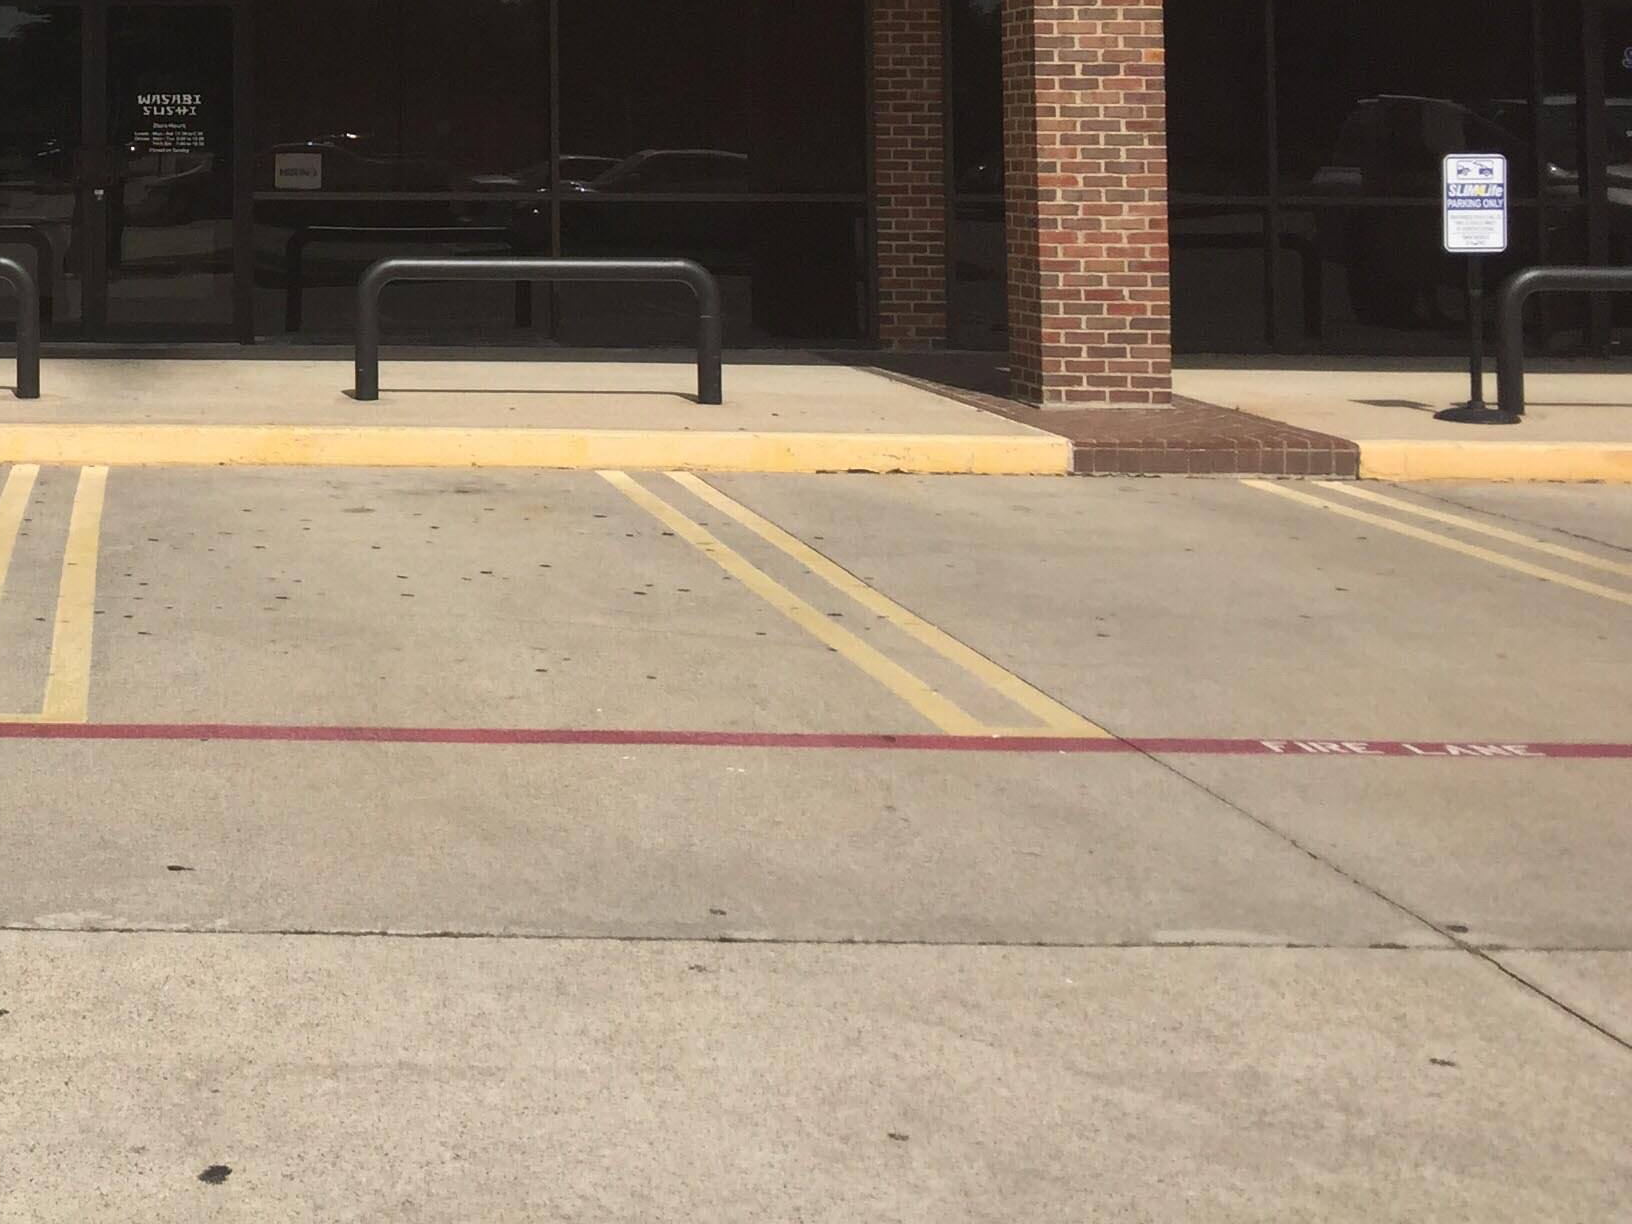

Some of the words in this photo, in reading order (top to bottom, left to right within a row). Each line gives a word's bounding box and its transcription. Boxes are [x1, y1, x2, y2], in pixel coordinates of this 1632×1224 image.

[137, 94, 202, 105] WASABI
[143, 106, 197, 116] SUSHI
[1483, 199, 1504, 208] ONLY
[1261, 740, 1384, 755] FIRE
[1402, 743, 1546, 757] LANE
